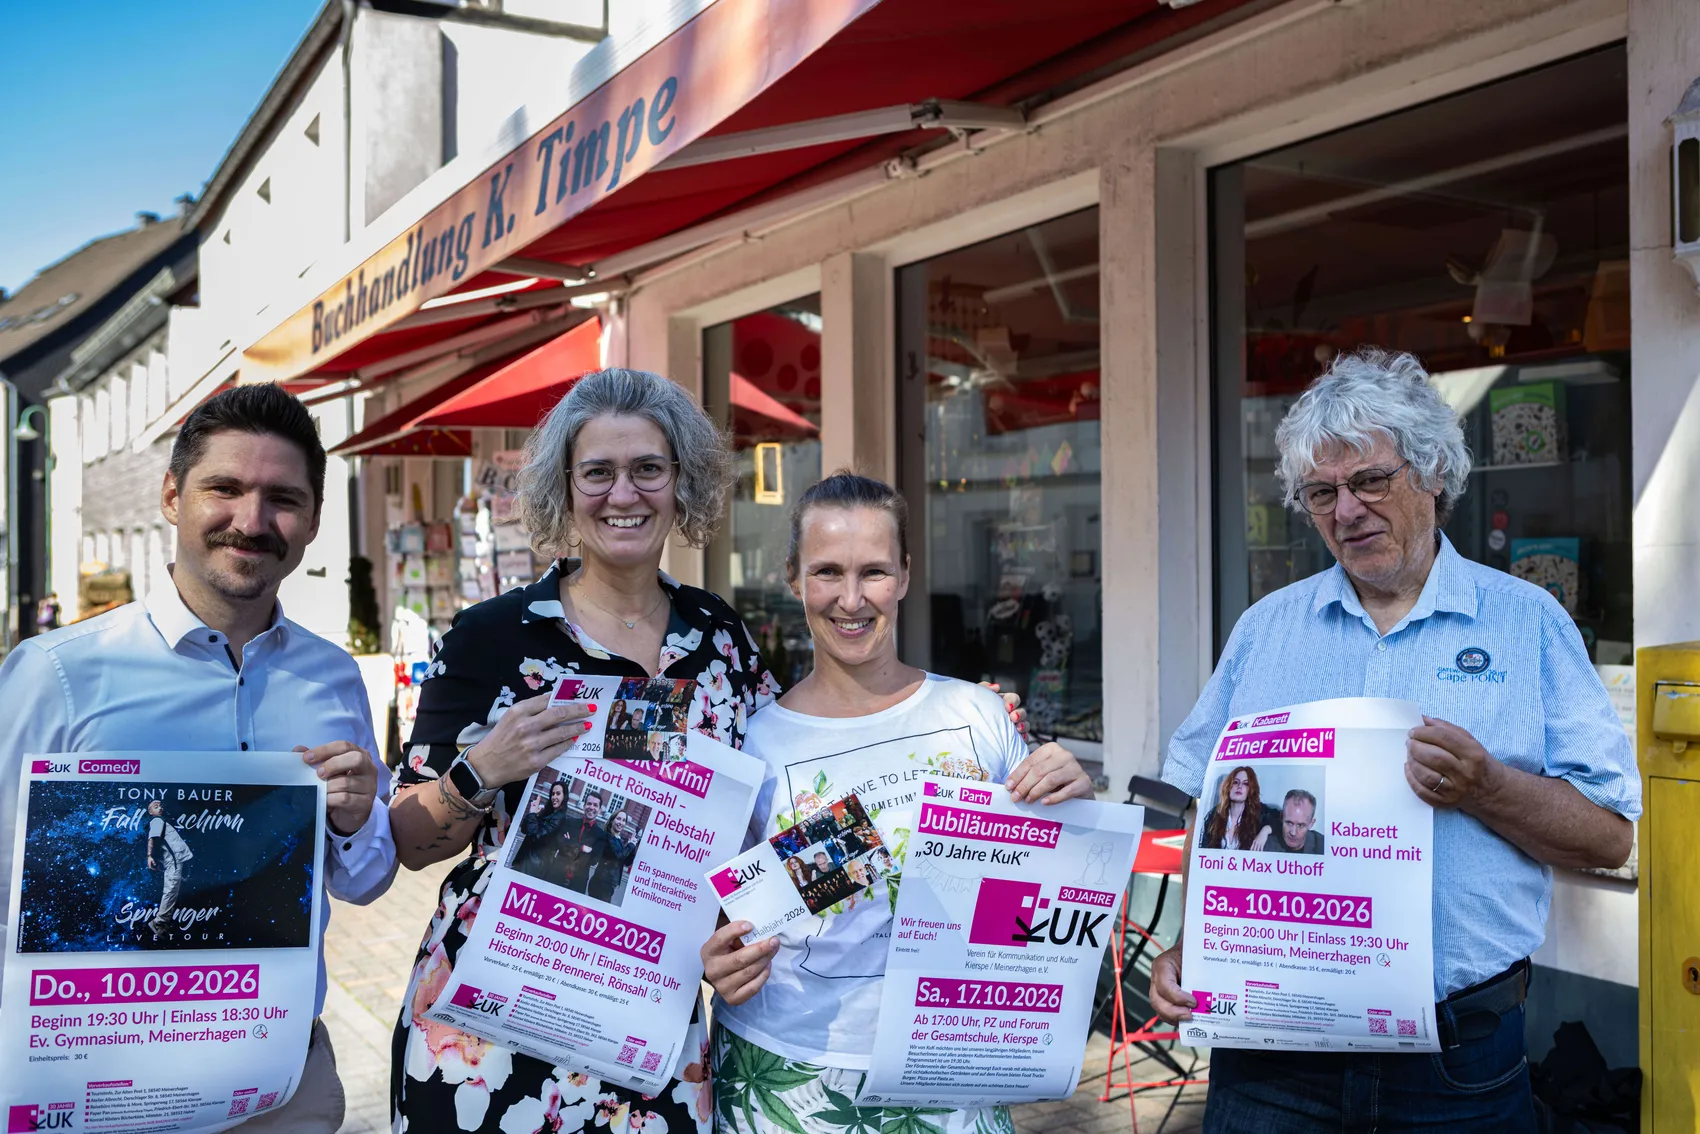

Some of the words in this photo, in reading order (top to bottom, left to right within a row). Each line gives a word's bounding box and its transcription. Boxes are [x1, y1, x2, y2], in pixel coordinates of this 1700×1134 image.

[311, 212, 476, 354] Buchhandlung
[482, 163, 515, 248] K.
[535, 76, 678, 216] Timpe
[1437, 671, 1467, 683] Cape
[1253, 714, 1288, 726] Kabarett
[581, 743, 601, 752] 2026
[1217, 738, 1267, 759] „Einer
[1270, 731, 1333, 754] zuviel“
[81, 761, 138, 774] Comedy
[575, 759, 623, 788] „Tatort
[625, 777, 677, 809] Rönsahl
[880, 773, 898, 786] TO
[118, 788, 168, 800] TONY
[178, 789, 232, 801] BAUER
[864, 792, 917, 814] SOMETIM
[960, 790, 991, 805] Party
[654, 811, 715, 845] Diebstahl
[920, 808, 1058, 844] Jubiläumsfest
[1332, 822, 1398, 839] Kabarett
[647, 830, 659, 846] in
[662, 835, 711, 863] h-Moll“
[915, 841, 944, 857] „30
[946, 844, 987, 862] Jahre
[991, 849, 1030, 866] KuK“
[1331, 846, 1358, 858] von
[1363, 845, 1391, 859] und
[1397, 846, 1422, 861] mit
[638, 861, 651, 873] Ein
[652, 868, 698, 890] spannendes
[1199, 855, 1224, 870] Toni
[1228, 857, 1237, 871] &
[1243, 858, 1272, 873] Max
[1277, 860, 1324, 876] Uthoff
[631, 886, 682, 911] Krimikonzert
[635, 876, 651, 886] und
[651, 879, 696, 903] interaktives
[1060, 889, 1075, 901] 30
[1076, 891, 1113, 906] JAHRE
[1205, 890, 1238, 916] Sa.,
[1246, 893, 1370, 923] 10.10.2026
[505, 887, 543, 923] Mi.,
[548, 903, 661, 957] 23.09.2026
[744, 935, 752, 943] 2.
[753, 918, 784, 939] Halbjahr
[784, 906, 805, 922] 2026
[901, 917, 916, 927] Wir
[918, 919, 945, 929] freuen
[898, 930, 912, 939] auf
[914, 930, 937, 941] Euch!
[1205, 923, 1239, 937] Beginn
[1243, 926, 1274, 939] 20:00
[1278, 929, 1299, 941] Uhr
[1308, 932, 1346, 946] Einlass
[1350, 935, 1382, 948] 19:30
[1387, 938, 1409, 951] Uhr
[495, 922, 533, 944] Beginn
[535, 935, 568, 954] 20:00
[570, 946, 590, 961] Uhr
[597, 955, 631, 975] Einlass
[633, 967, 661, 984] 19:00
[663, 976, 681, 991] Uhr
[967, 949, 986, 957] Verein
[998, 951, 1045, 961] Kommunikation
[1060, 956, 1078, 964] Kultur
[1204, 939, 1217, 950] Ev.
[1221, 940, 1286, 958] Gymnasium,
[1290, 947, 1371, 966] Meinerzhagen
[489, 938, 550, 967] Historische
[552, 958, 605, 986] Brennerei,
[608, 976, 648, 998] Rönsahl
[965, 961, 989, 971] Kierspe
[994, 963, 1037, 974] Meinerzhagen
[35, 975, 90, 1002] Do.,
[101, 969, 256, 997] 10.09.2026
[917, 980, 949, 1006] Sa.,
[957, 984, 1059, 1008] 17.10.2026
[31, 1015, 82, 1031] Beginn
[88, 1012, 127, 1026] 19:30
[132, 1011, 159, 1024] Uhr
[171, 1009, 217, 1023] Einlass
[222, 1008, 259, 1021] 18:30
[264, 1007, 288, 1019] Uhr
[914, 1014, 928, 1025] Ab
[932, 1015, 959, 1026] 17:00
[962, 1016, 980, 1028] Uhr,
[984, 1017, 997, 1028] PZ
[999, 1018, 1017, 1028] und
[1020, 1019, 1049, 1030] Forum
[30, 1035, 49, 1048] Ev.
[55, 1031, 144, 1049] Gymnasium,
[149, 1028, 246, 1043] Meinerzhagen
[912, 1029, 929, 1040] der
[931, 1030, 1000, 1044] Gesamtschule,
[1003, 1033, 1038, 1046] Kierspe
[1187, 1028, 1208, 1038] mbg
